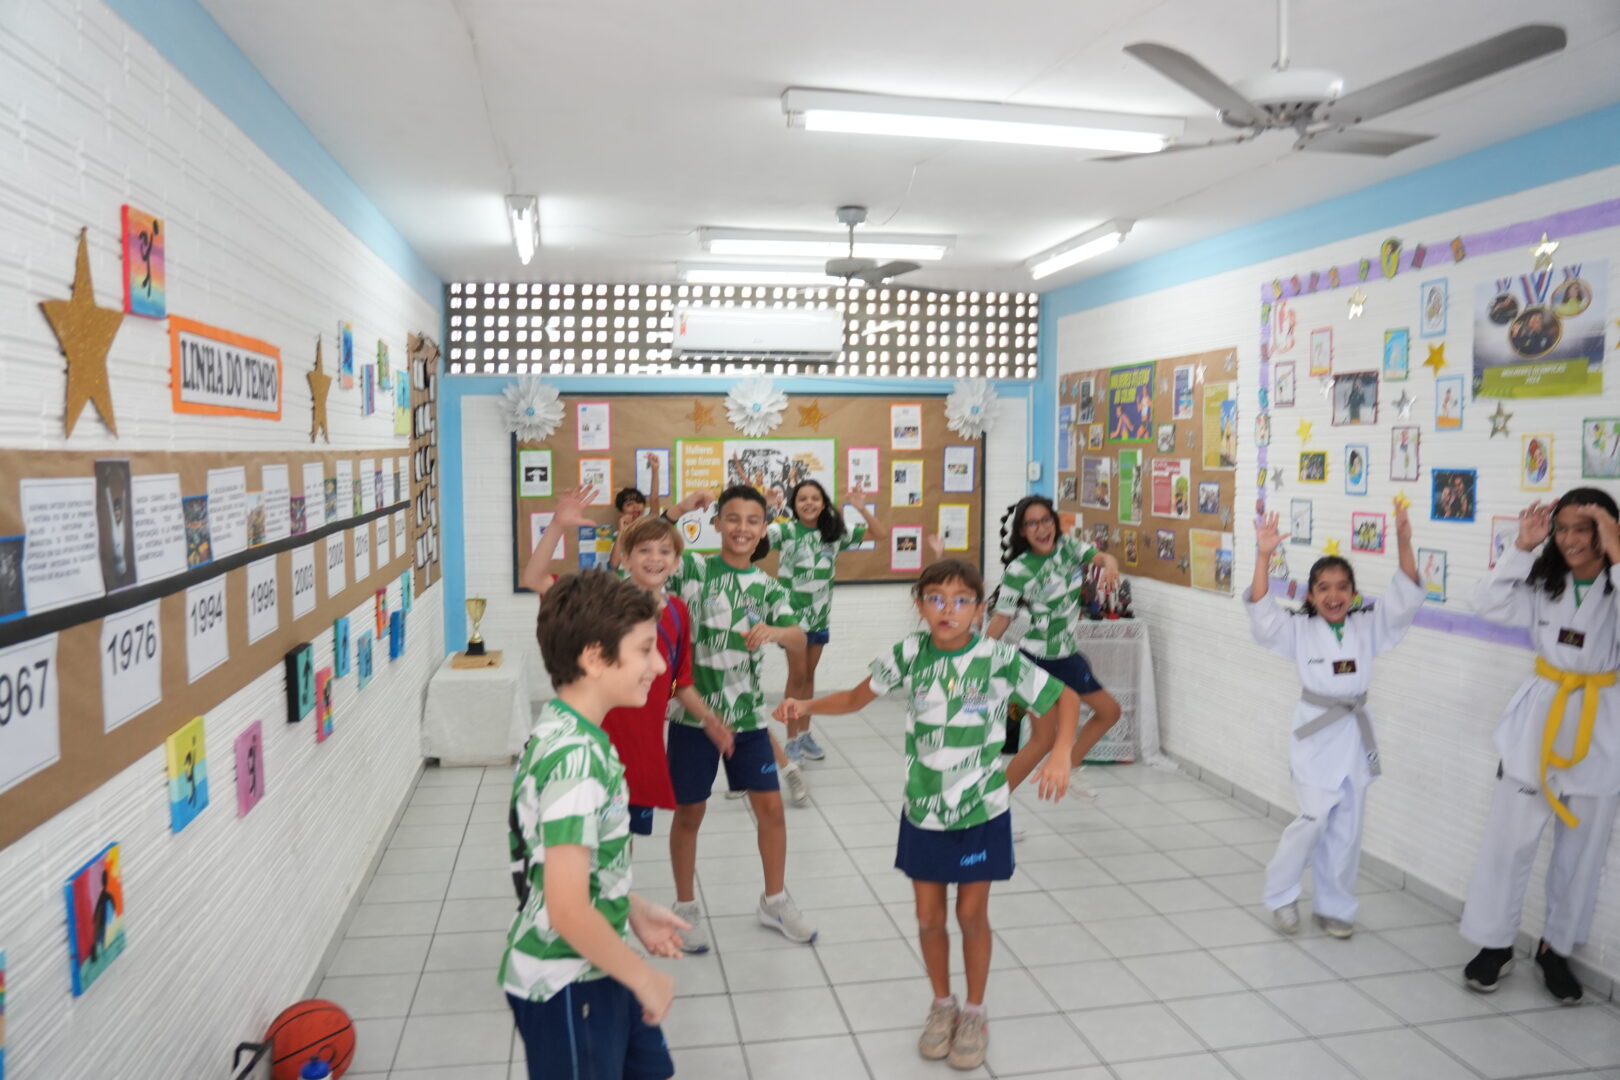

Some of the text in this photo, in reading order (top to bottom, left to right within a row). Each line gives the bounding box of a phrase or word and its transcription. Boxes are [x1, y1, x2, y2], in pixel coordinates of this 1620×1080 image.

[181, 339, 278, 402] LINHA DO TEMPO
[250, 577, 276, 616] 1996
[294, 564, 314, 596] 2003
[190, 591, 223, 637] 1994
[106, 620, 157, 676] 1976
